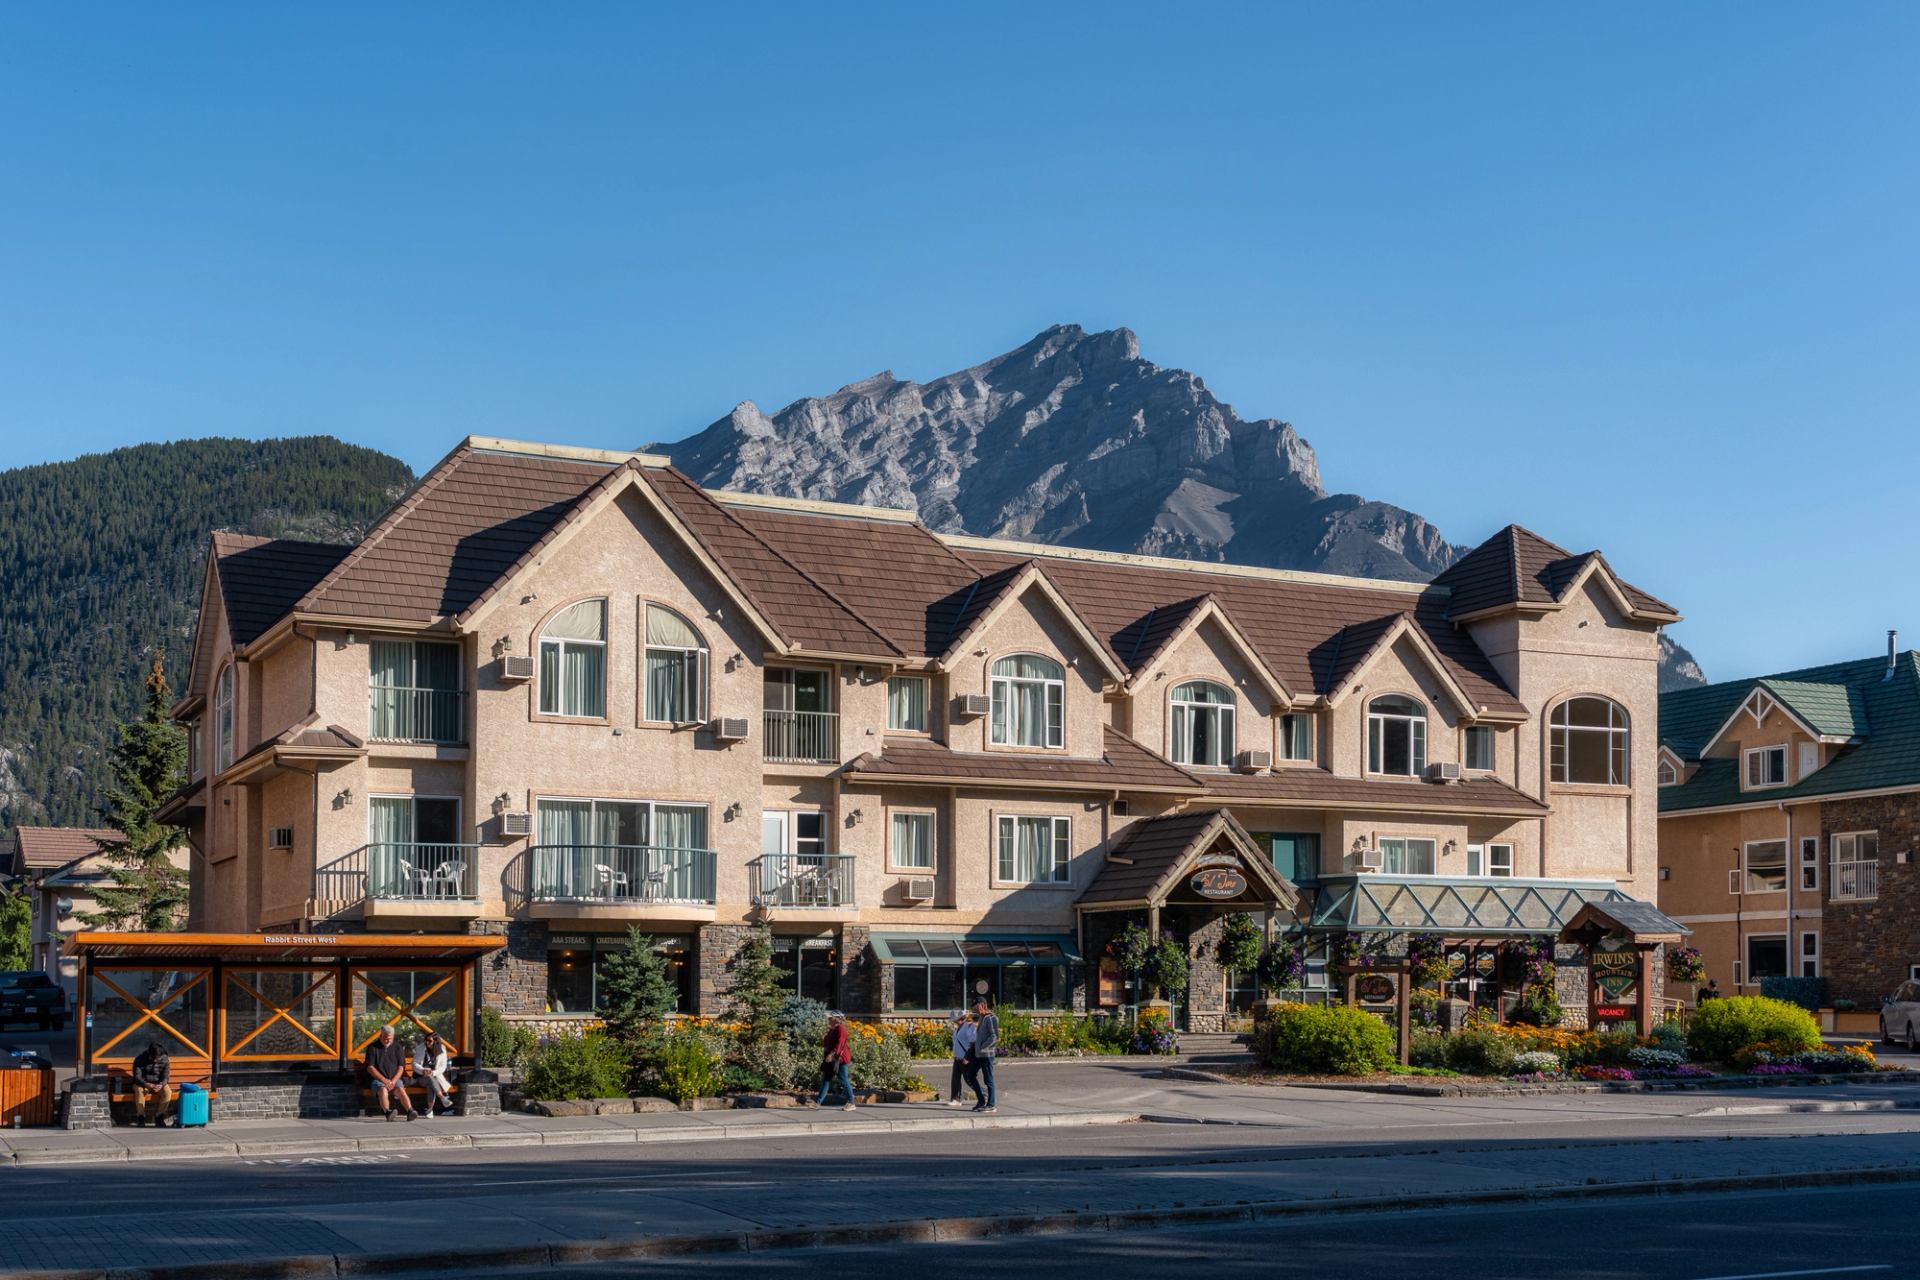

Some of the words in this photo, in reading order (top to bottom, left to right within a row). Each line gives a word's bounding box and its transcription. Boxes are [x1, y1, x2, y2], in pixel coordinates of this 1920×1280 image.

[552, 936, 564, 944] AAA
[565, 936, 586, 944] STEAKS
[804, 939, 833, 947] BREAKFAST
[1592, 952, 1634, 966] IRWIN'S
[1595, 969, 1633, 978] MOUNTAIN
[1606, 977, 1623, 987] INN
[1598, 1008, 1626, 1016] VACANCY
